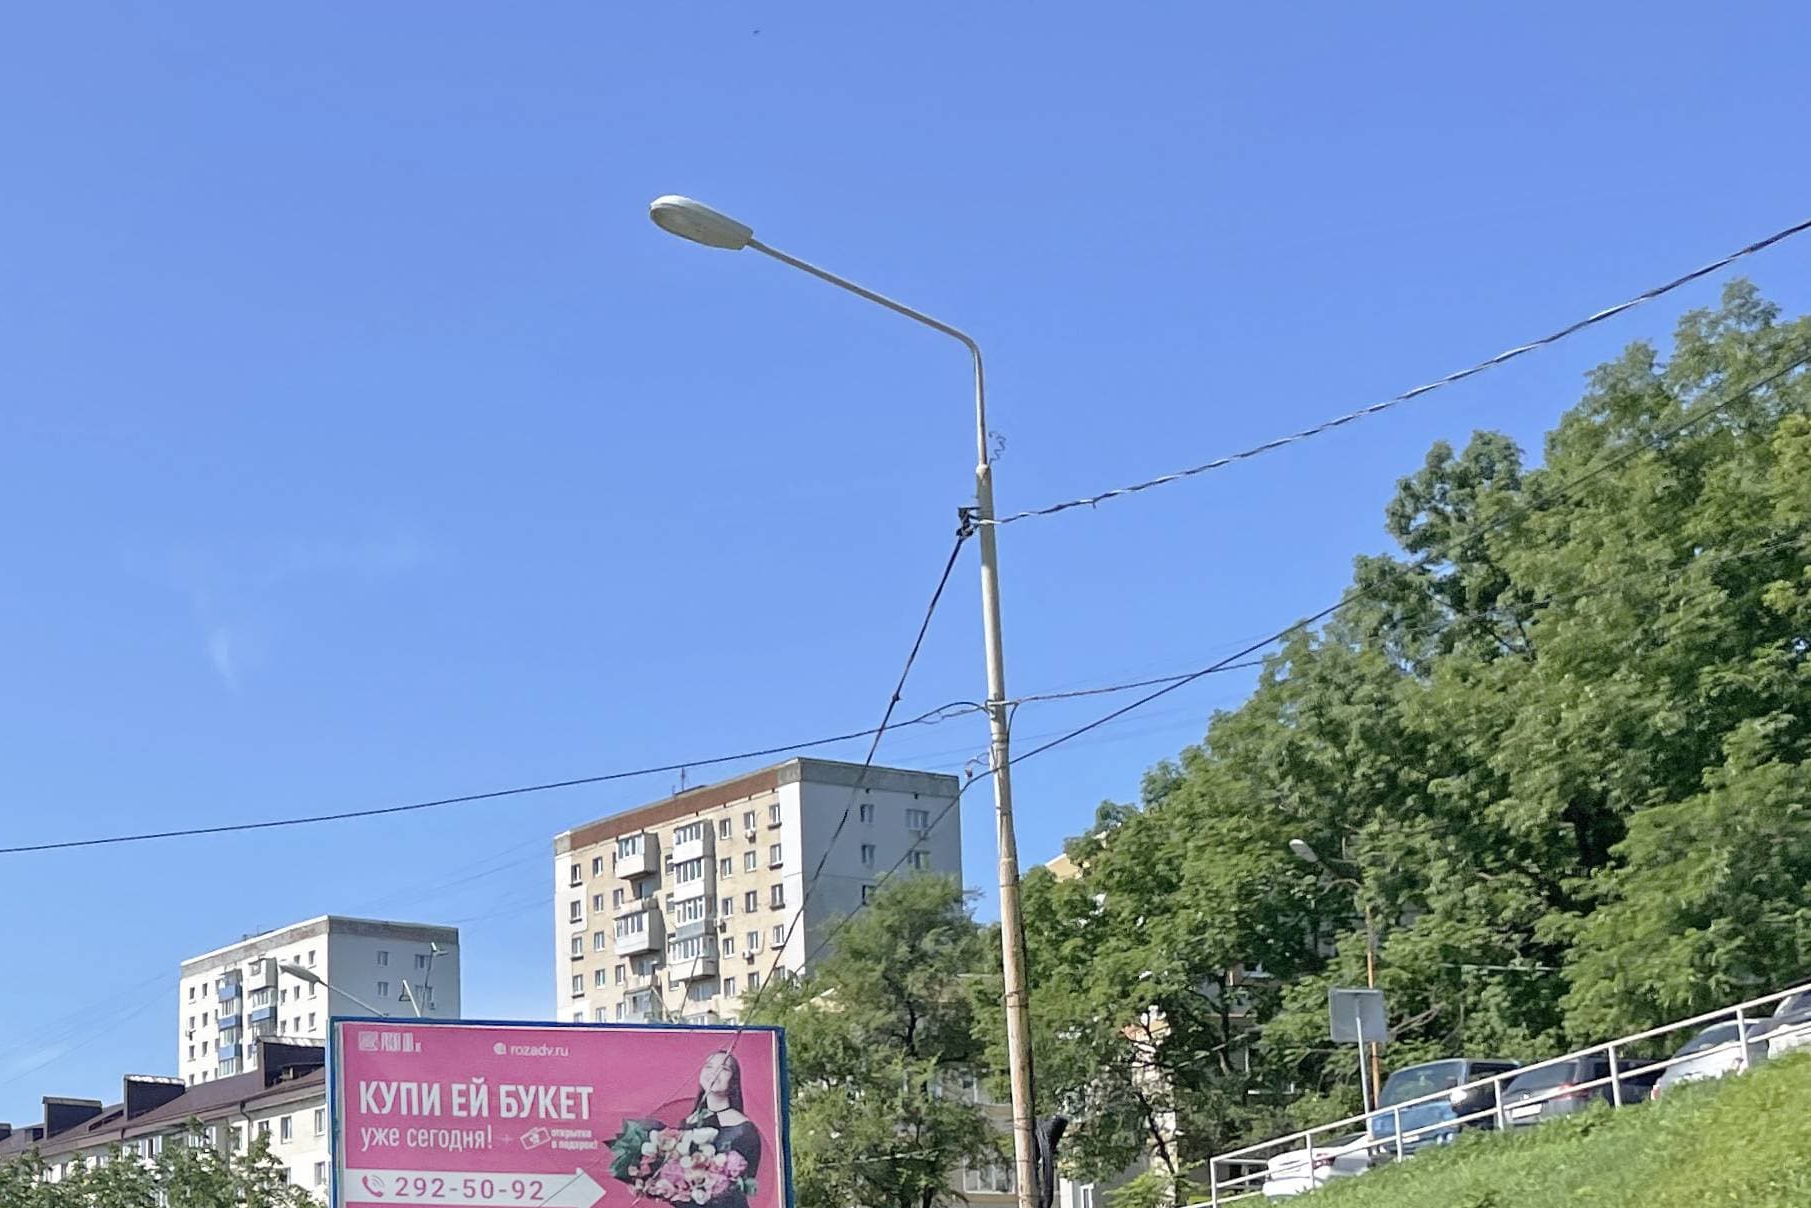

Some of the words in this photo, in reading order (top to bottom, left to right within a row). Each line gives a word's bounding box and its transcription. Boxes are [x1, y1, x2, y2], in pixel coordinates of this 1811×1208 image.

[510, 1044, 569, 1057] rozadv.ru
[359, 1081, 441, 1117] КУПИ
[451, 1077, 489, 1118] ЕЙ
[499, 1084, 594, 1120] БУКЕТ
[361, 1127, 400, 1152] уже
[406, 1125, 493, 1152] сегодня!
[395, 1176, 545, 1201] 292-50-92
